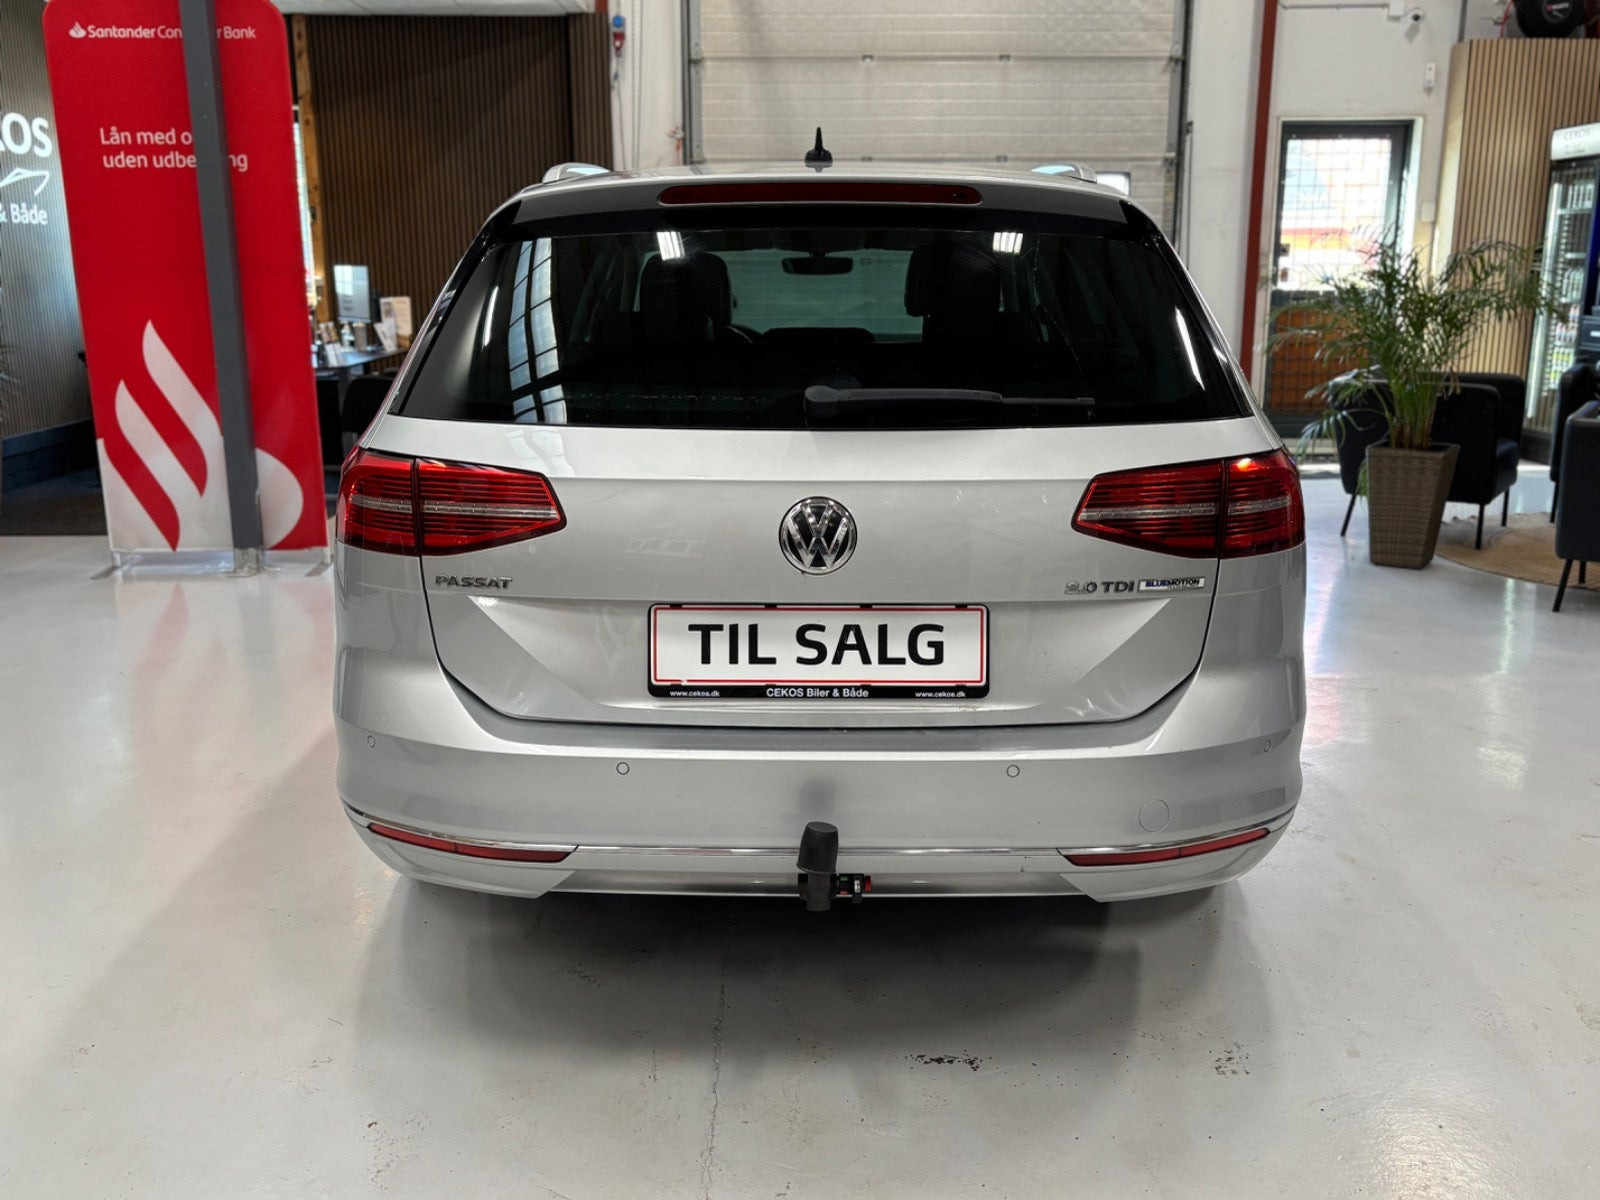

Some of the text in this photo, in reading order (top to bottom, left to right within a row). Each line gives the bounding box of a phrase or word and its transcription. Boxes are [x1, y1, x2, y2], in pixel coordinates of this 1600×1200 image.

[88, 25, 156, 38] Santander
[223, 26, 256, 39] Bank
[0, 112, 52, 158] OS
[100, 126, 132, 145] Lån
[136, 127, 177, 145] med
[103, 150, 148, 168] uden
[10, 202, 48, 225] Både
[435, 575, 513, 588] PASSAT
[1100, 580, 1135, 593] TDI
[688, 623, 944, 666] TIL SALG
[766, 687, 869, 698] CEKOS Biler & Både
